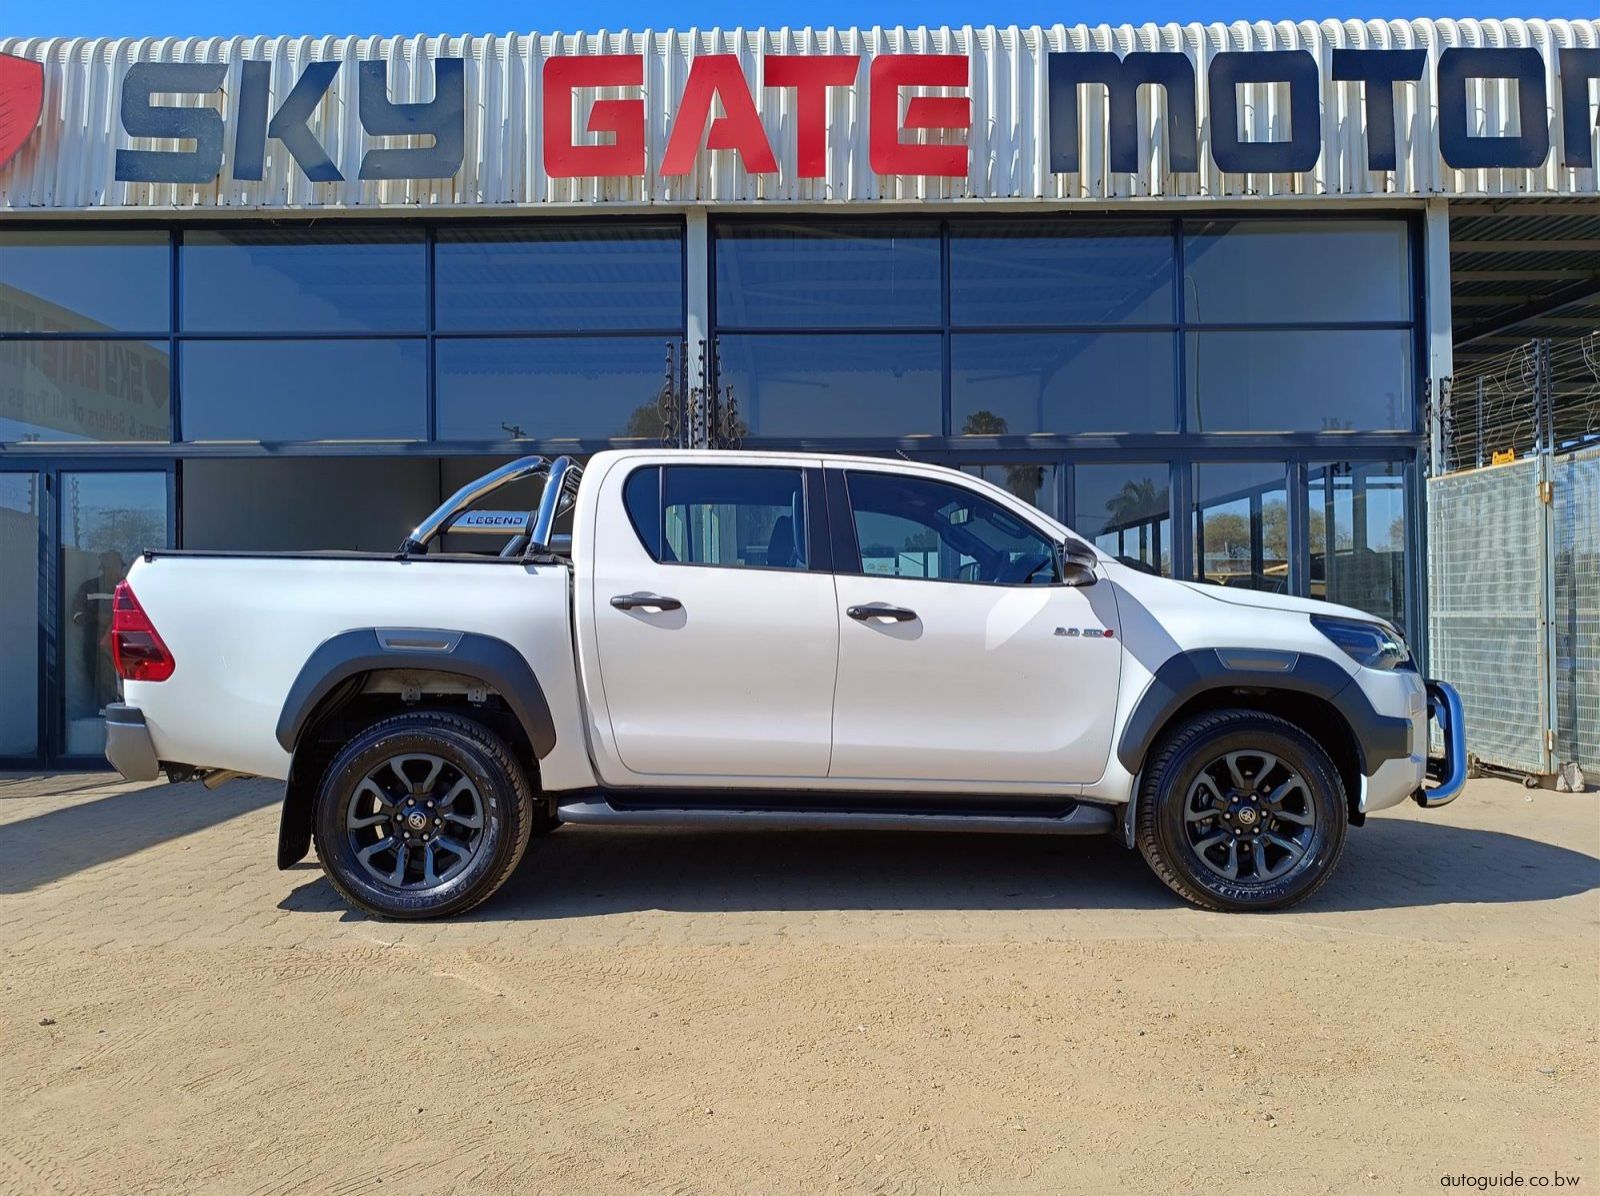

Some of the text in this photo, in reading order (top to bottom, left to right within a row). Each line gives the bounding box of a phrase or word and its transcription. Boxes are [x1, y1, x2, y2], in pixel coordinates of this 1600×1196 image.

[115, 57, 465, 183] SKY
[543, 54, 970, 178] GATE
[467, 516, 523, 524] LEGEND
